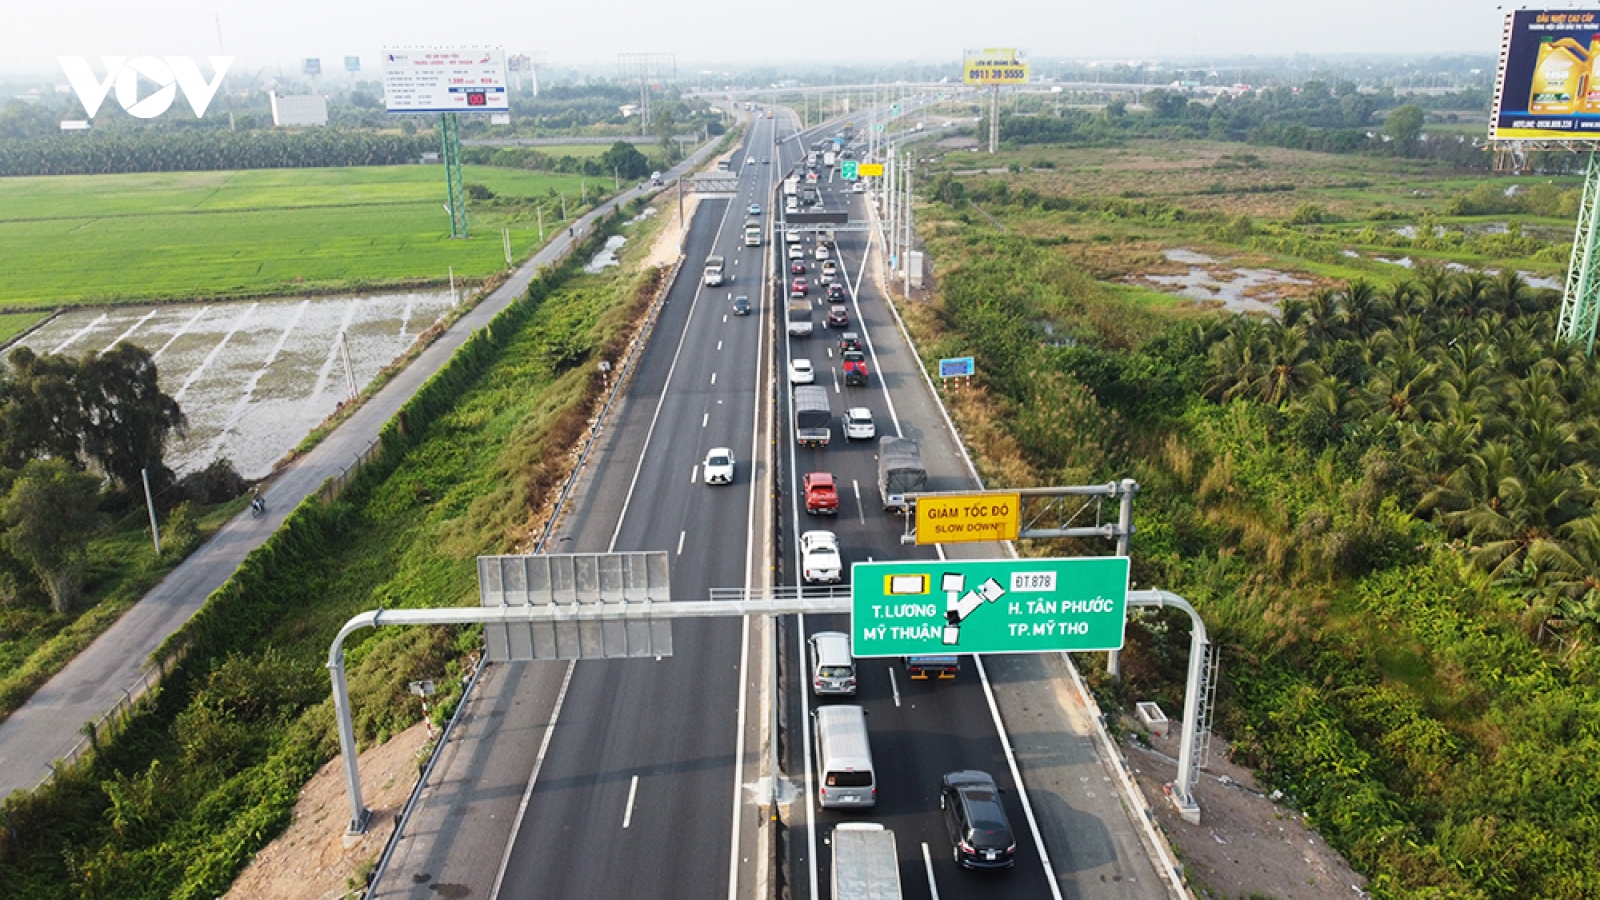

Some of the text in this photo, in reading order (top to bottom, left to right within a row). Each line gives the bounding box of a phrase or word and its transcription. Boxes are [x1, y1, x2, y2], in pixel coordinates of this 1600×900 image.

[969, 69, 1025, 79] 0911 39 5555
[963, 502, 988, 518] TỐC
[991, 502, 1010, 519] ĐỘ
[935, 522, 998, 534] SLOW DOWN
[1015, 574, 1052, 589] ĐT.878
[1008, 595, 1114, 615] H. TÂN PHƯỚC
[863, 622, 942, 642] MỸ THUẬN
[1058, 621, 1089, 635] THO
